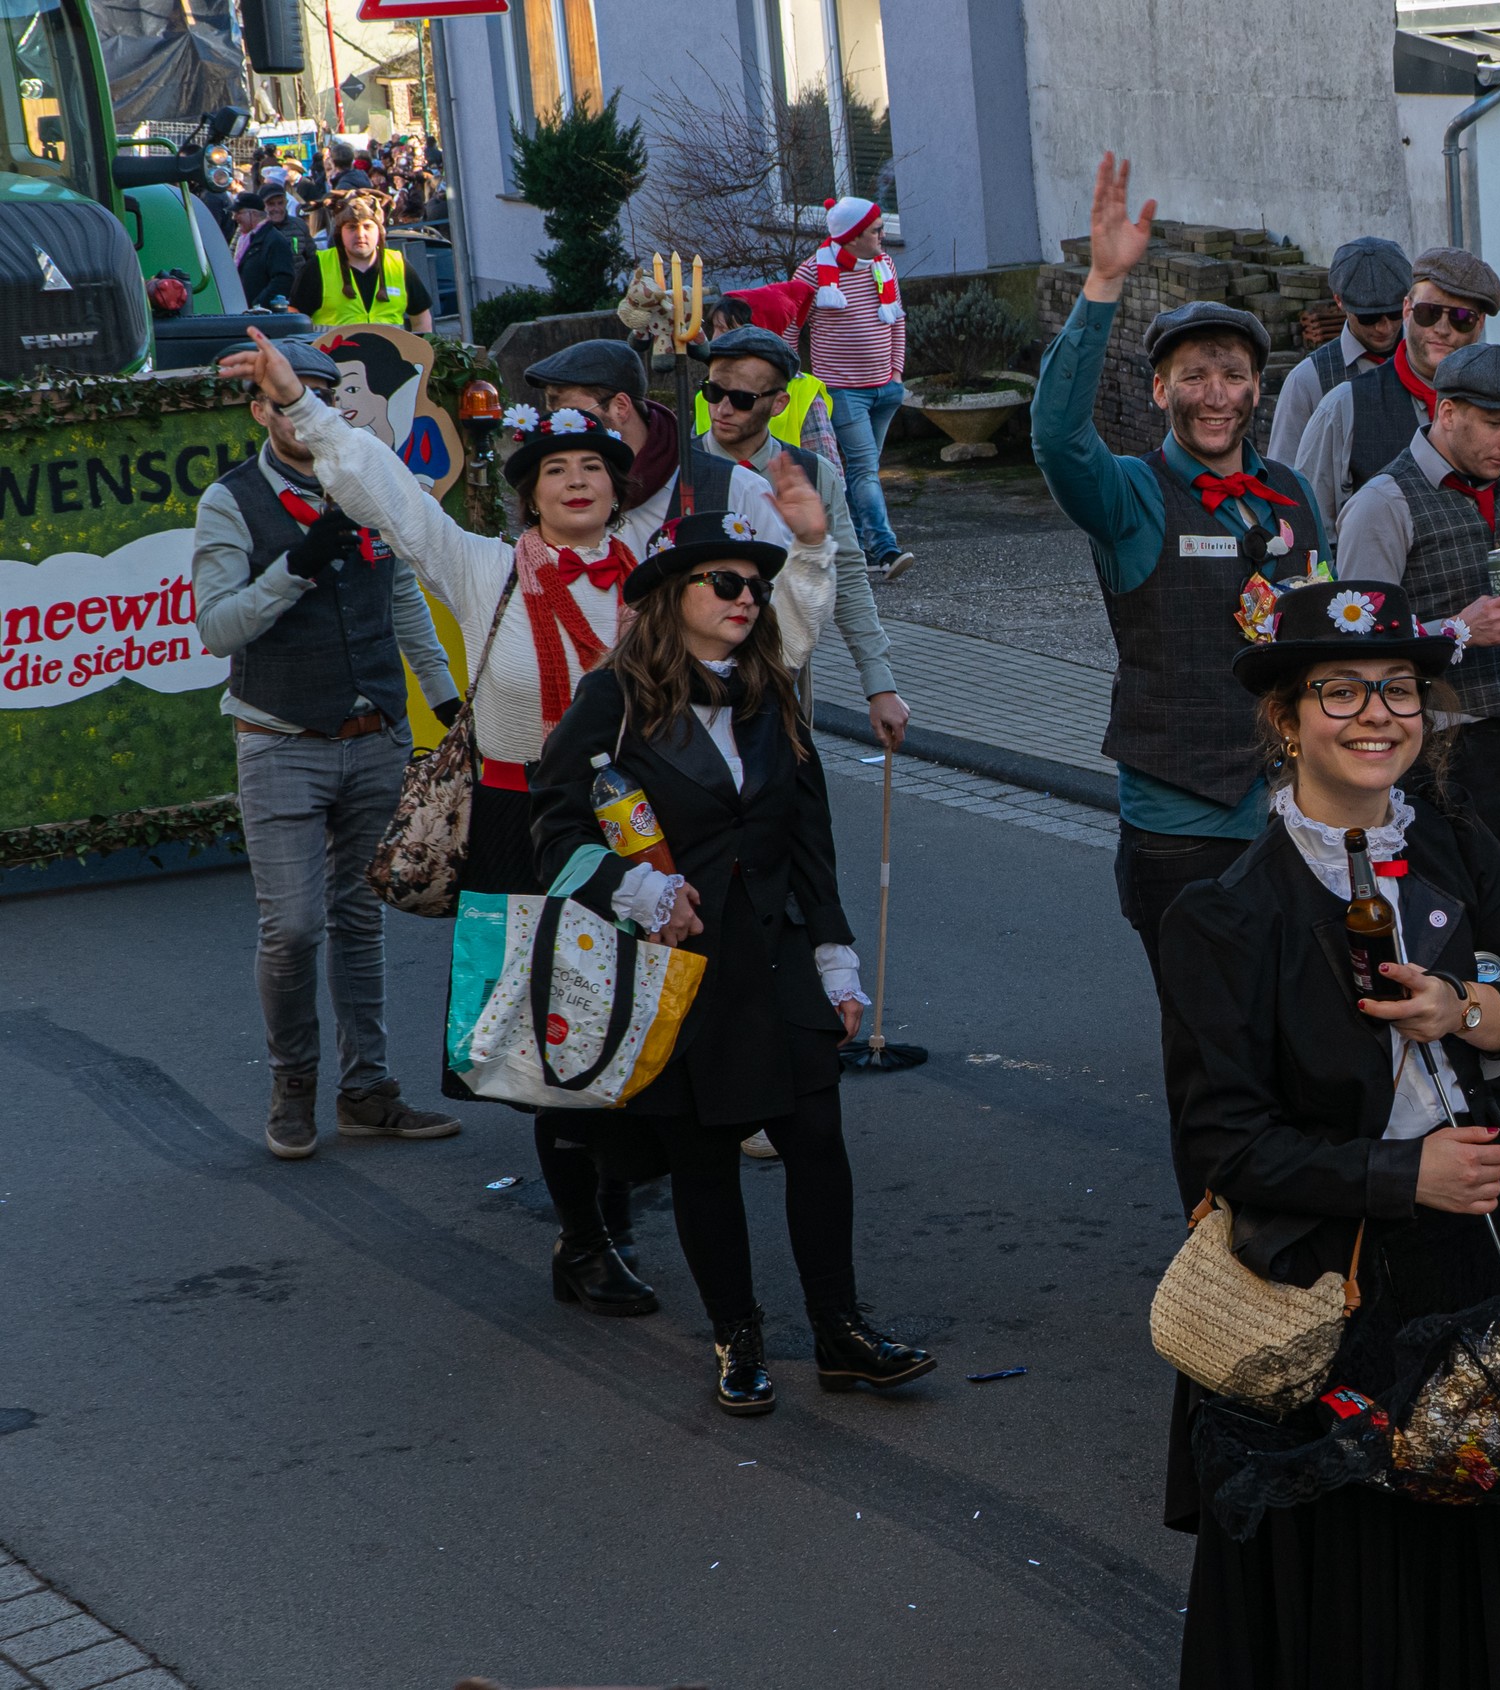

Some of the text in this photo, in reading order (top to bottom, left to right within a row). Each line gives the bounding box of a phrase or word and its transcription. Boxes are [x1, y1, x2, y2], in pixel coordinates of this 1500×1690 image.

[20, 331, 99, 350] FENDT
[3, 652, 63, 691] die
[68, 635, 191, 688] sieben
[566, 992, 593, 1012] LIFE
